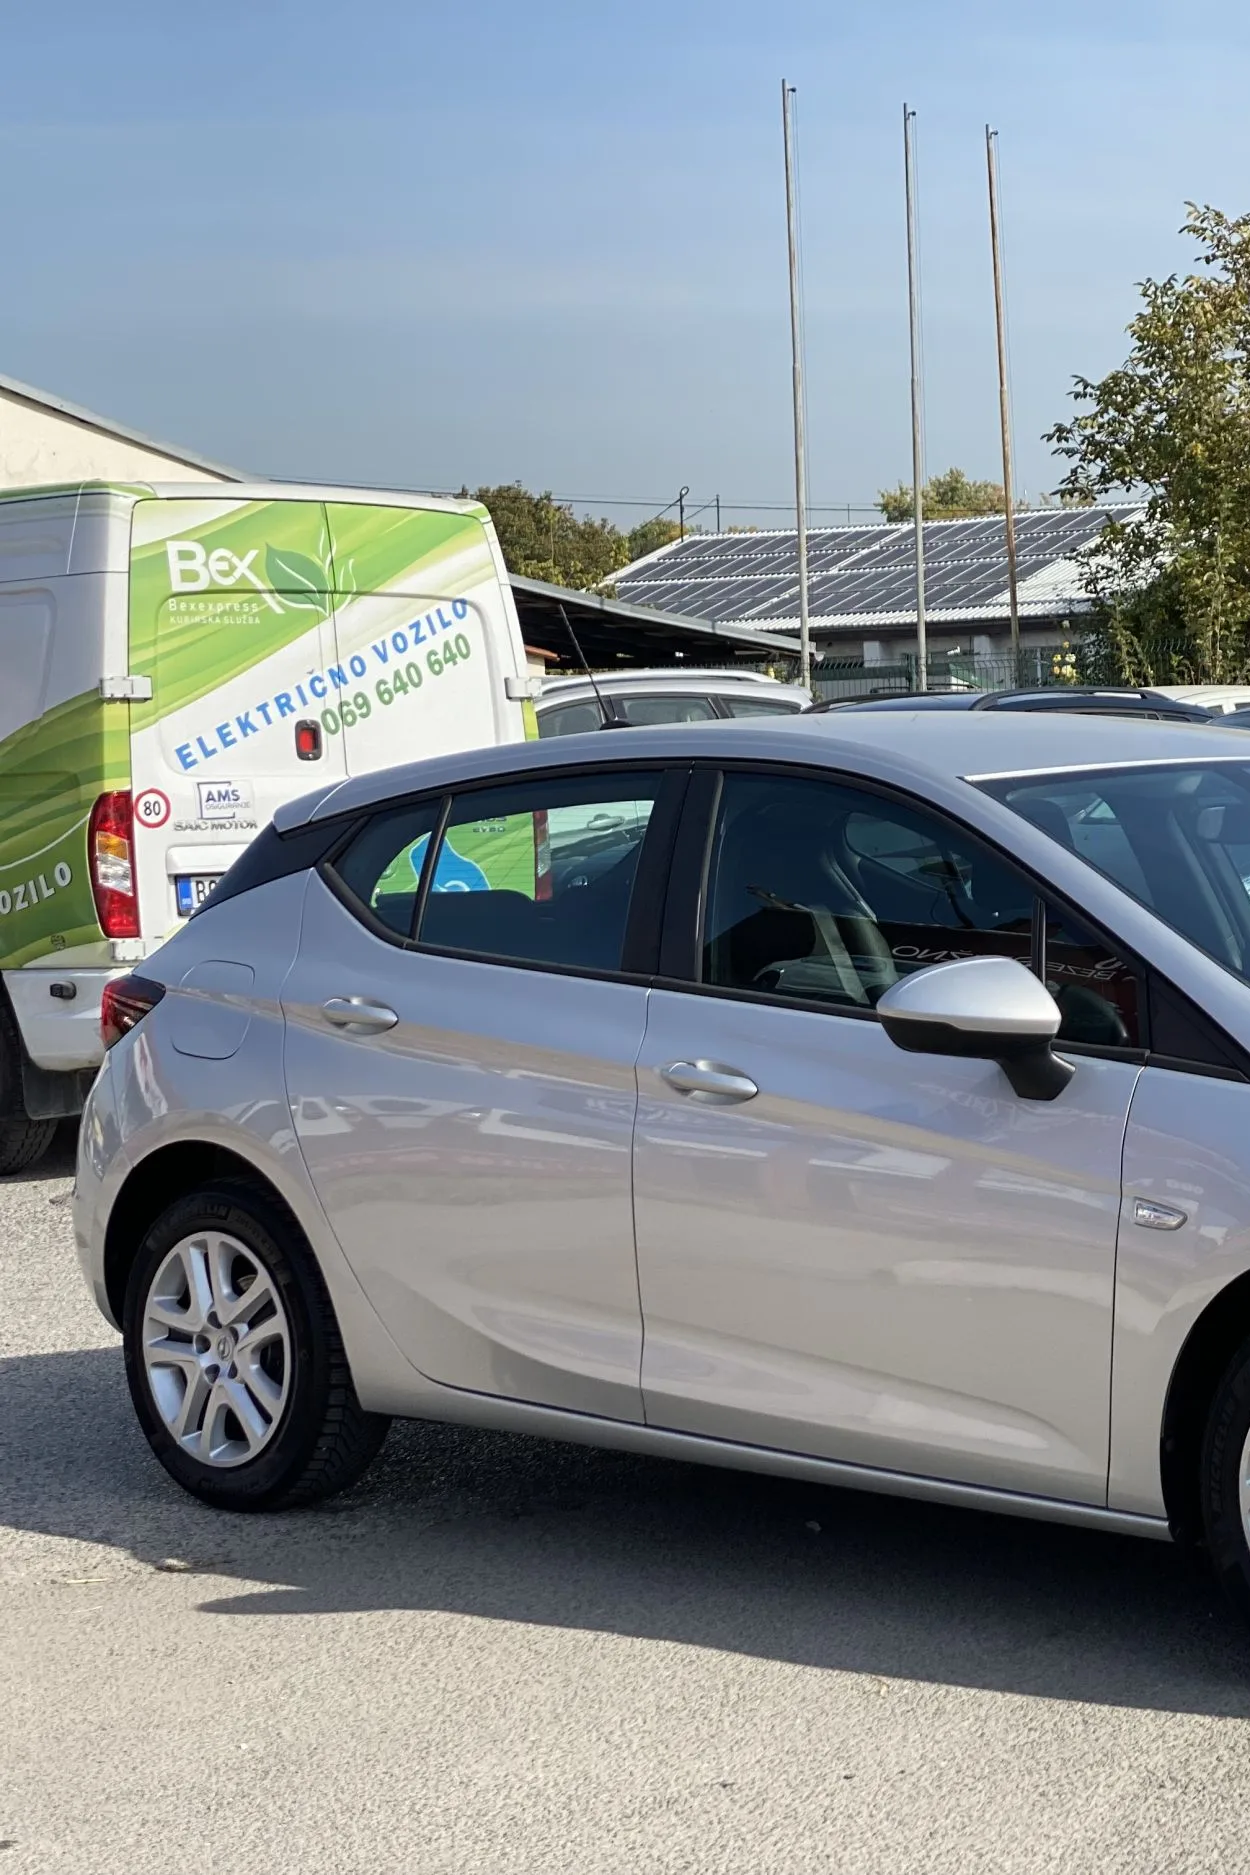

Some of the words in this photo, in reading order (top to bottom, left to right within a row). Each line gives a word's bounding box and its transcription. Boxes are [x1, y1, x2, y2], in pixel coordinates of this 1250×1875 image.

[168, 598, 259, 613] Bexexpress
[174, 655, 367, 771] ELEKTRIČNO
[371, 597, 469, 664] VOZILO
[320, 691, 372, 736] 069
[375, 661, 424, 707] 640
[426, 632, 472, 677] 640
[205, 789, 241, 803] AMS
[143, 800, 161, 816] 80
[174, 822, 209, 832] SAIC
[210, 819, 258, 831] MOTOR
